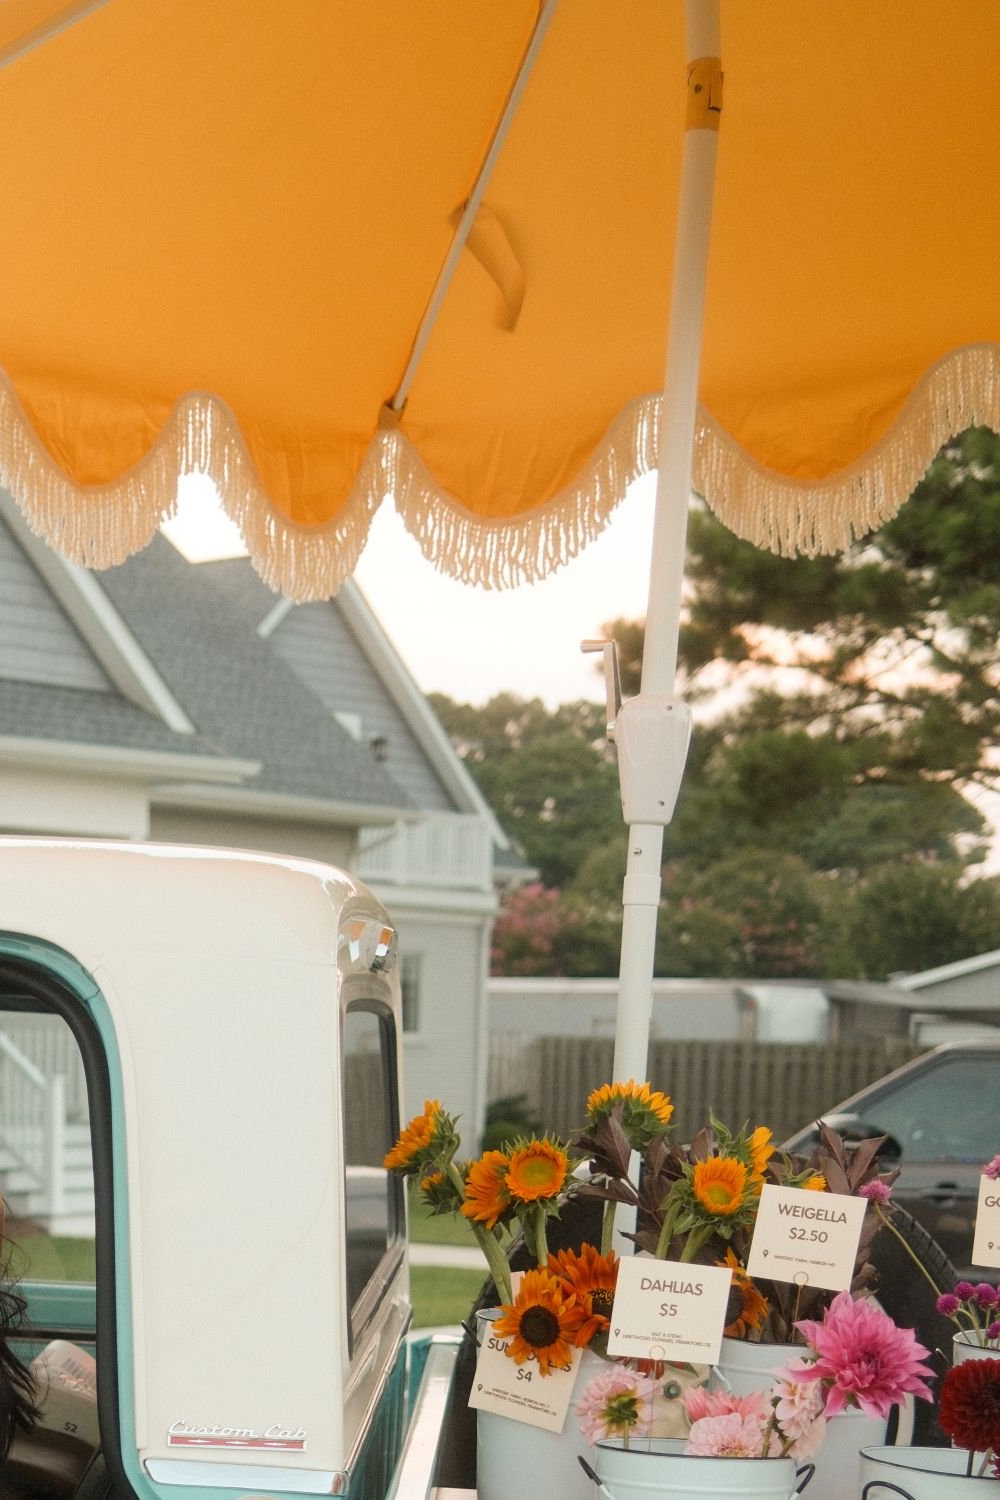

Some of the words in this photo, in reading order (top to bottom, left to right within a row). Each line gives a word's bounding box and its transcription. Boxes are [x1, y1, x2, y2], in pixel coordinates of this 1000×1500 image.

[778, 1203, 847, 1224] WEIGELLA
[789, 1227, 829, 1243] $2.50
[640, 1278, 703, 1296] DAHLIAS
[659, 1303, 678, 1317] $5
[168, 1419, 259, 1438] Custom
[263, 1423, 307, 1439] Cab
